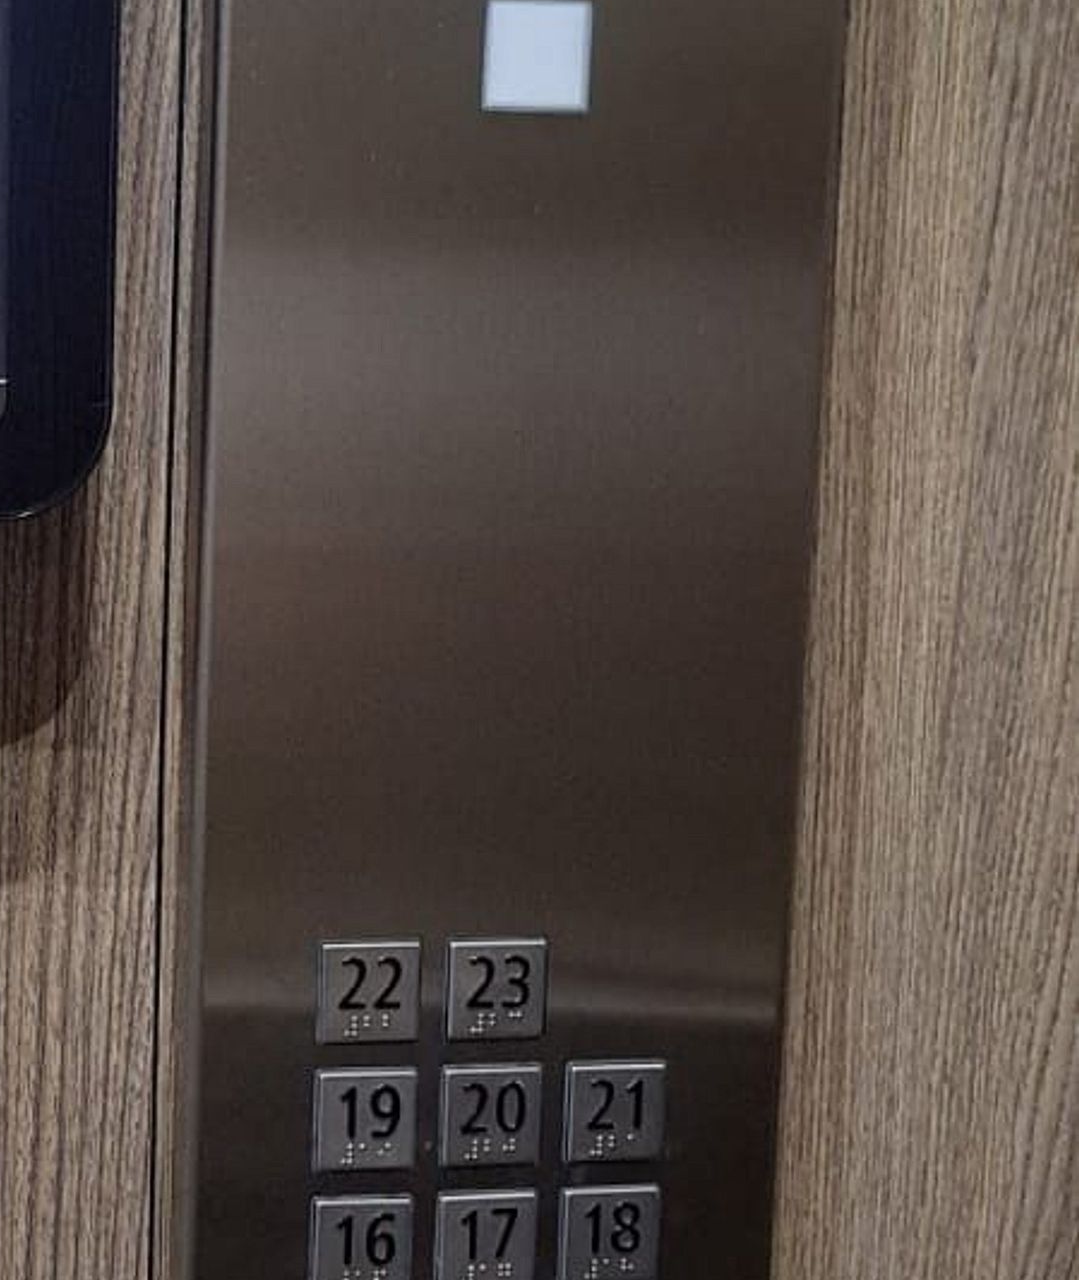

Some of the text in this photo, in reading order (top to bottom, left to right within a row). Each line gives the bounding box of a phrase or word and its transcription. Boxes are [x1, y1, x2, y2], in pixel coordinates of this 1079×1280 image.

[339, 956, 402, 1010] 22
[466, 956, 530, 1010] 23
[340, 1083, 401, 1139] 19
[460, 1081, 527, 1136] 20
[587, 1079, 645, 1131] 21
[337, 1213, 395, 1266] 16
[461, 1207, 518, 1261] 17
[587, 1202, 641, 1254] 18
